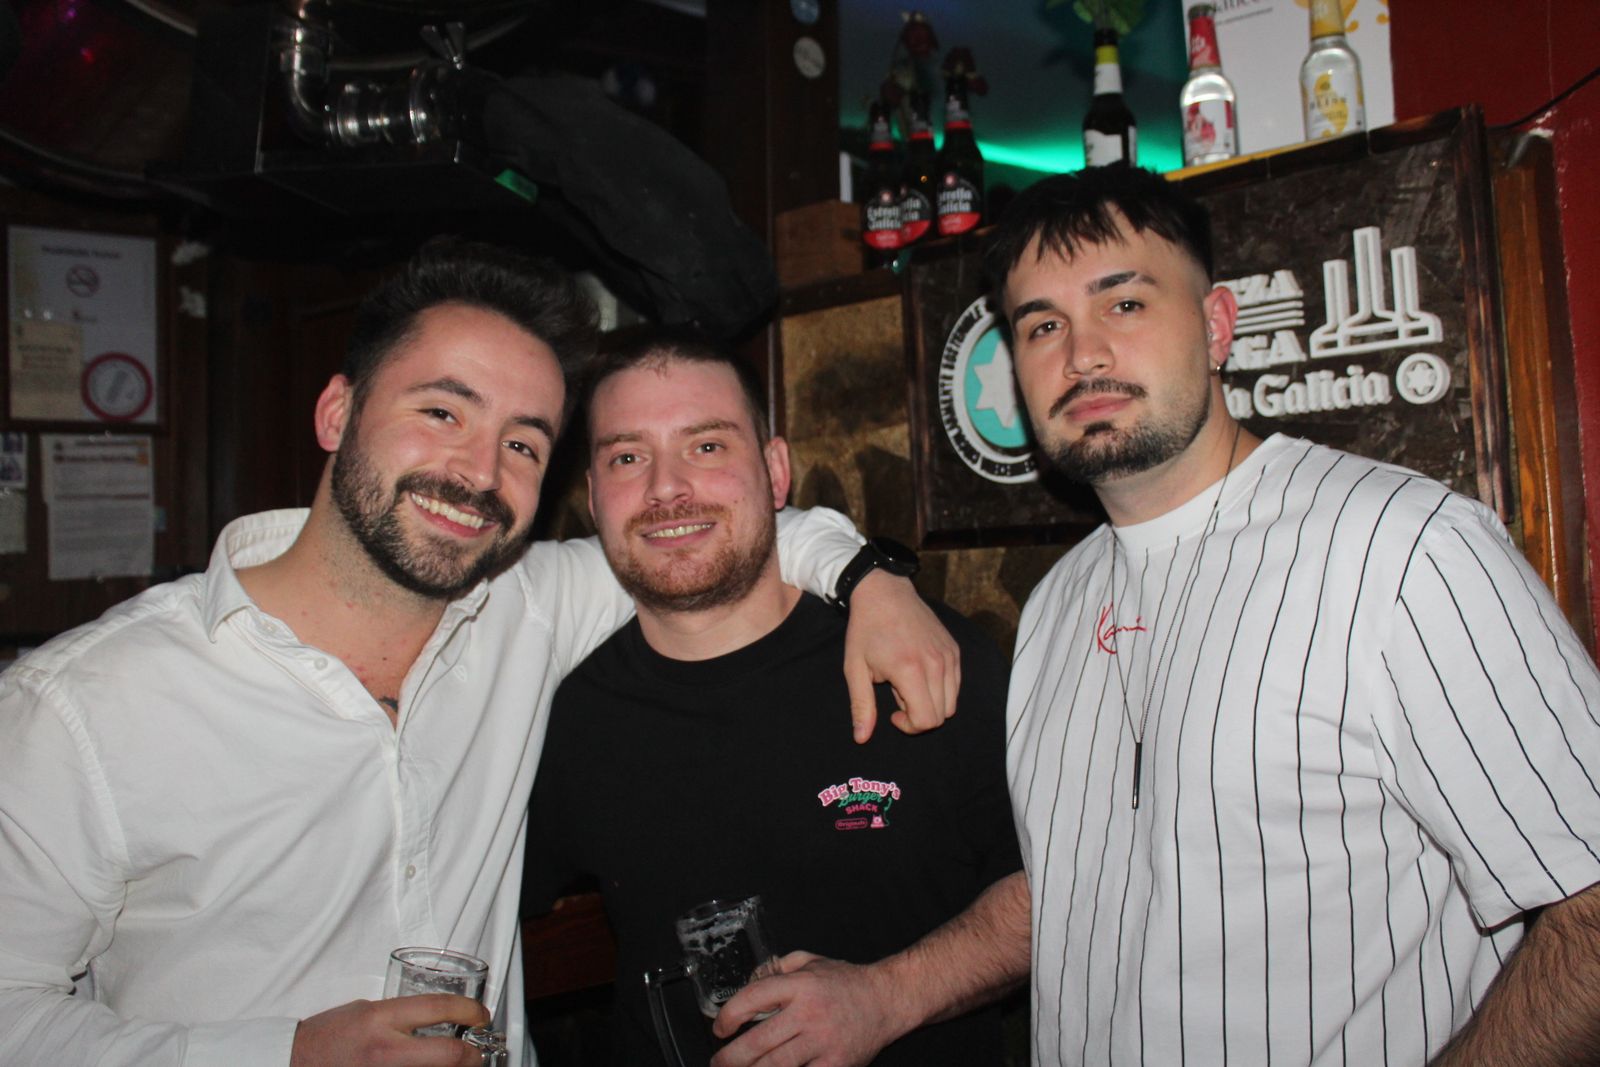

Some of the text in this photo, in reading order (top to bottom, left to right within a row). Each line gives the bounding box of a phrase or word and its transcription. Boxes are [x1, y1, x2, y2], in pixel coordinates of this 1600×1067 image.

[1254, 364, 1393, 418] Galicia
[817, 777, 901, 807] Big Tony's
[845, 802, 878, 815] SHACK
